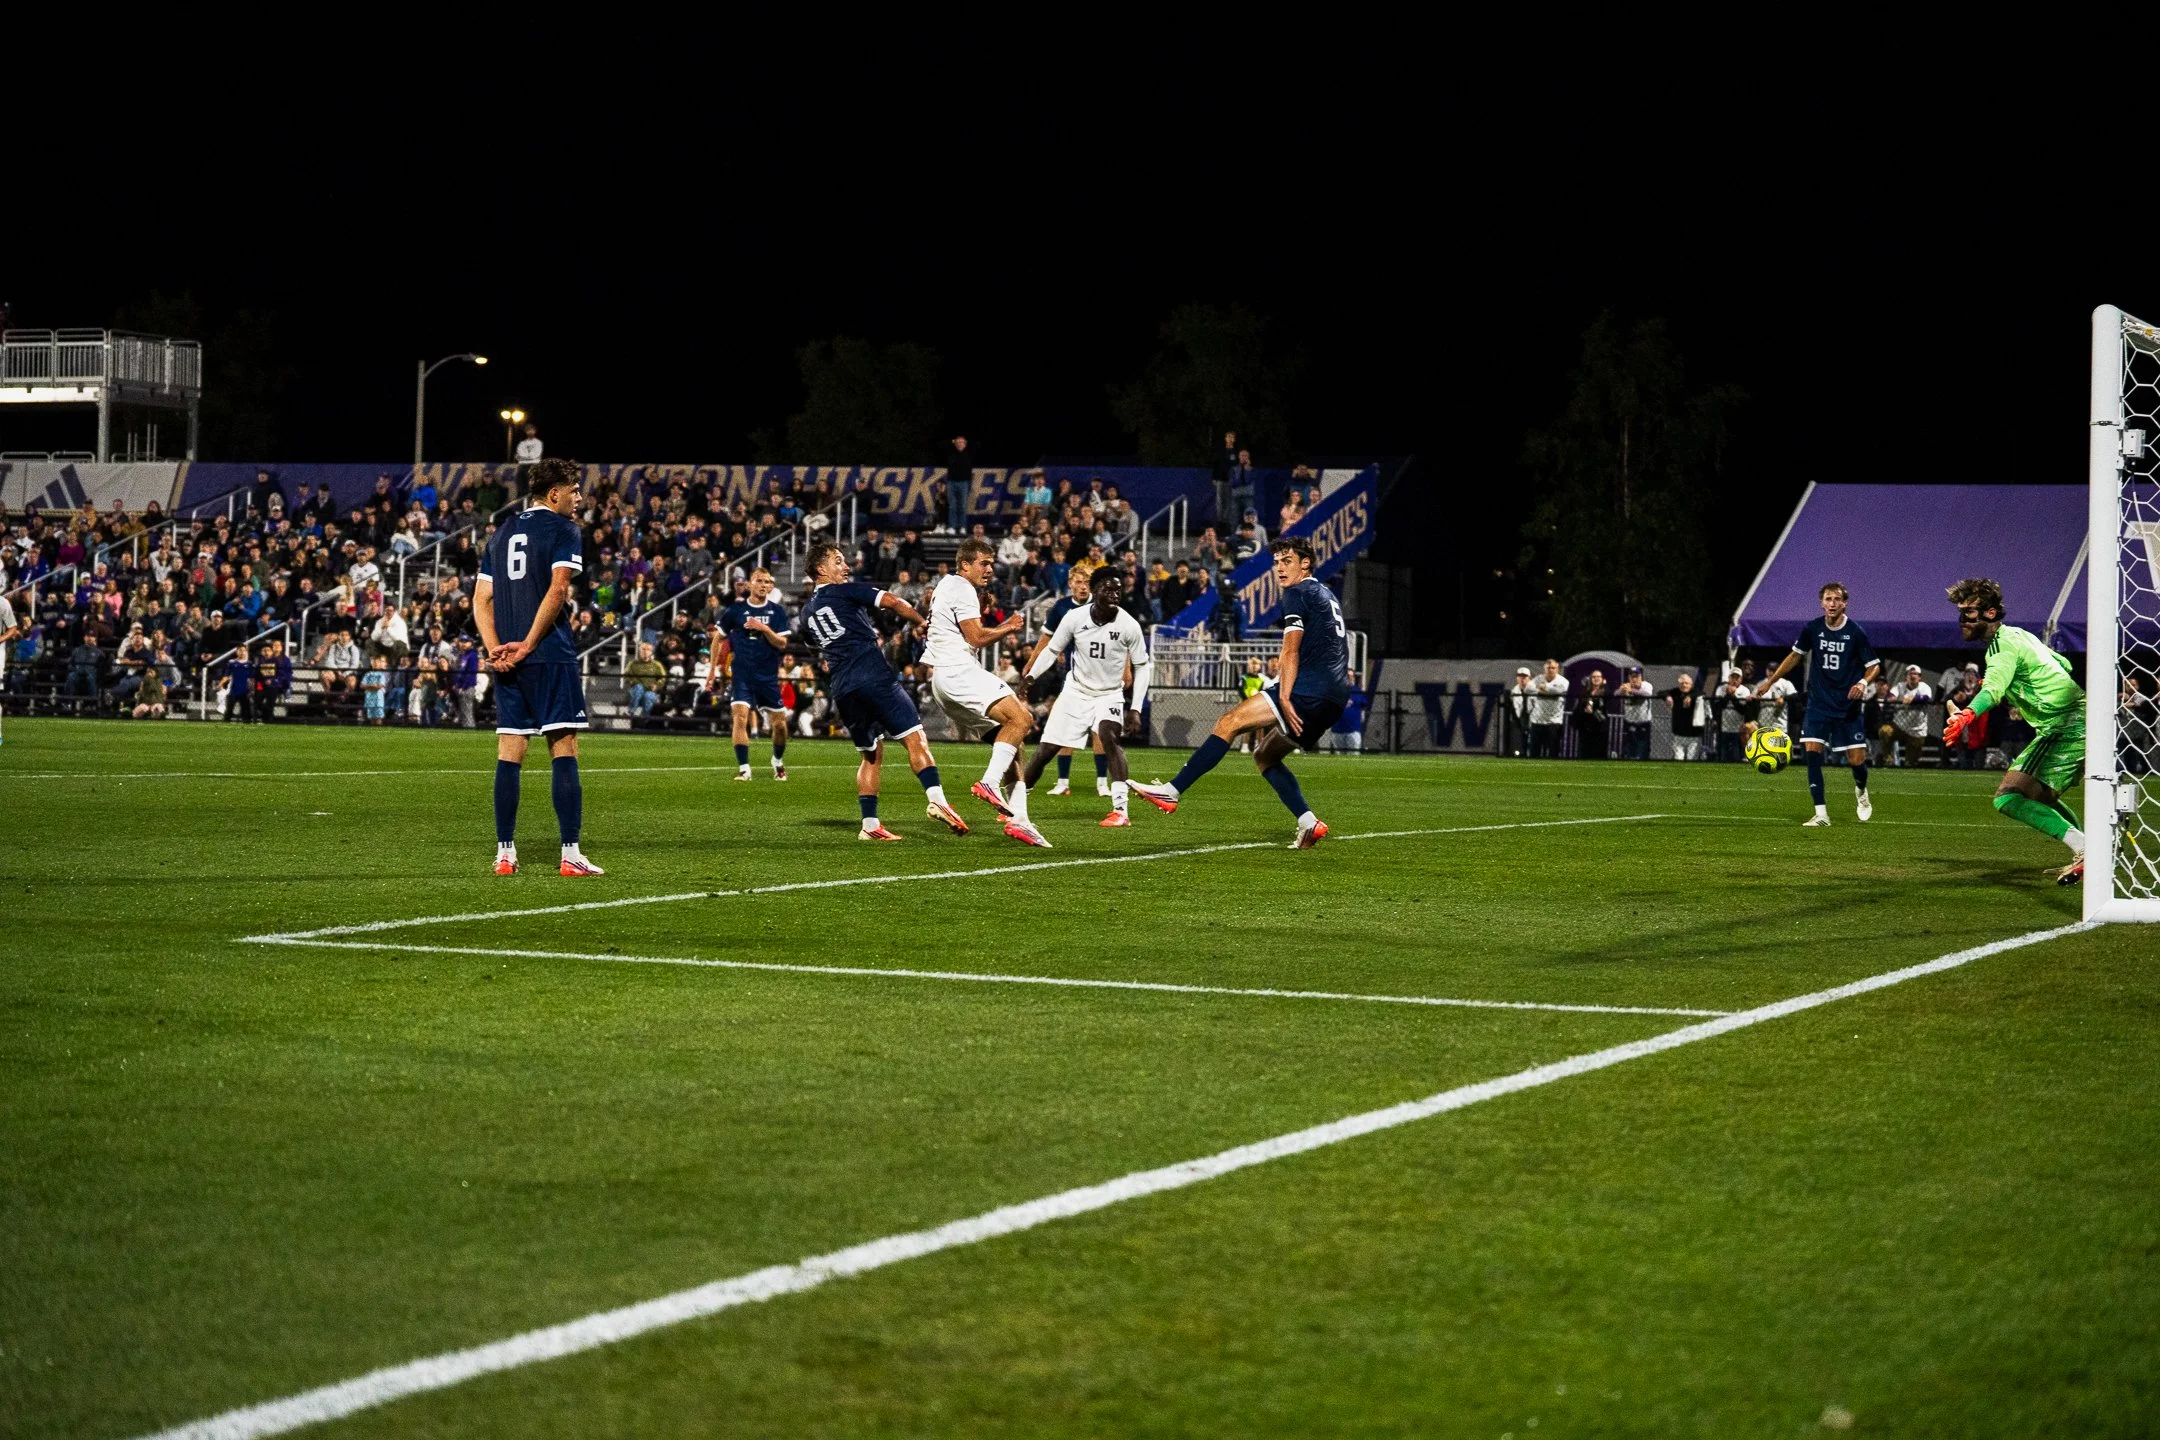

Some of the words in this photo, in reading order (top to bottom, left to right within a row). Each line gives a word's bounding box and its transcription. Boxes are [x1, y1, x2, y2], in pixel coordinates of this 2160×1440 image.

[507, 533, 528, 581] 6
[807, 605, 846, 649] 10
[1329, 598, 1346, 638] 5
[1089, 641, 1106, 659] 21
[1109, 631, 1120, 641] W
[1819, 639, 1846, 653] PSU
[1821, 652, 1841, 670] 19
[1415, 682, 1505, 747] W
